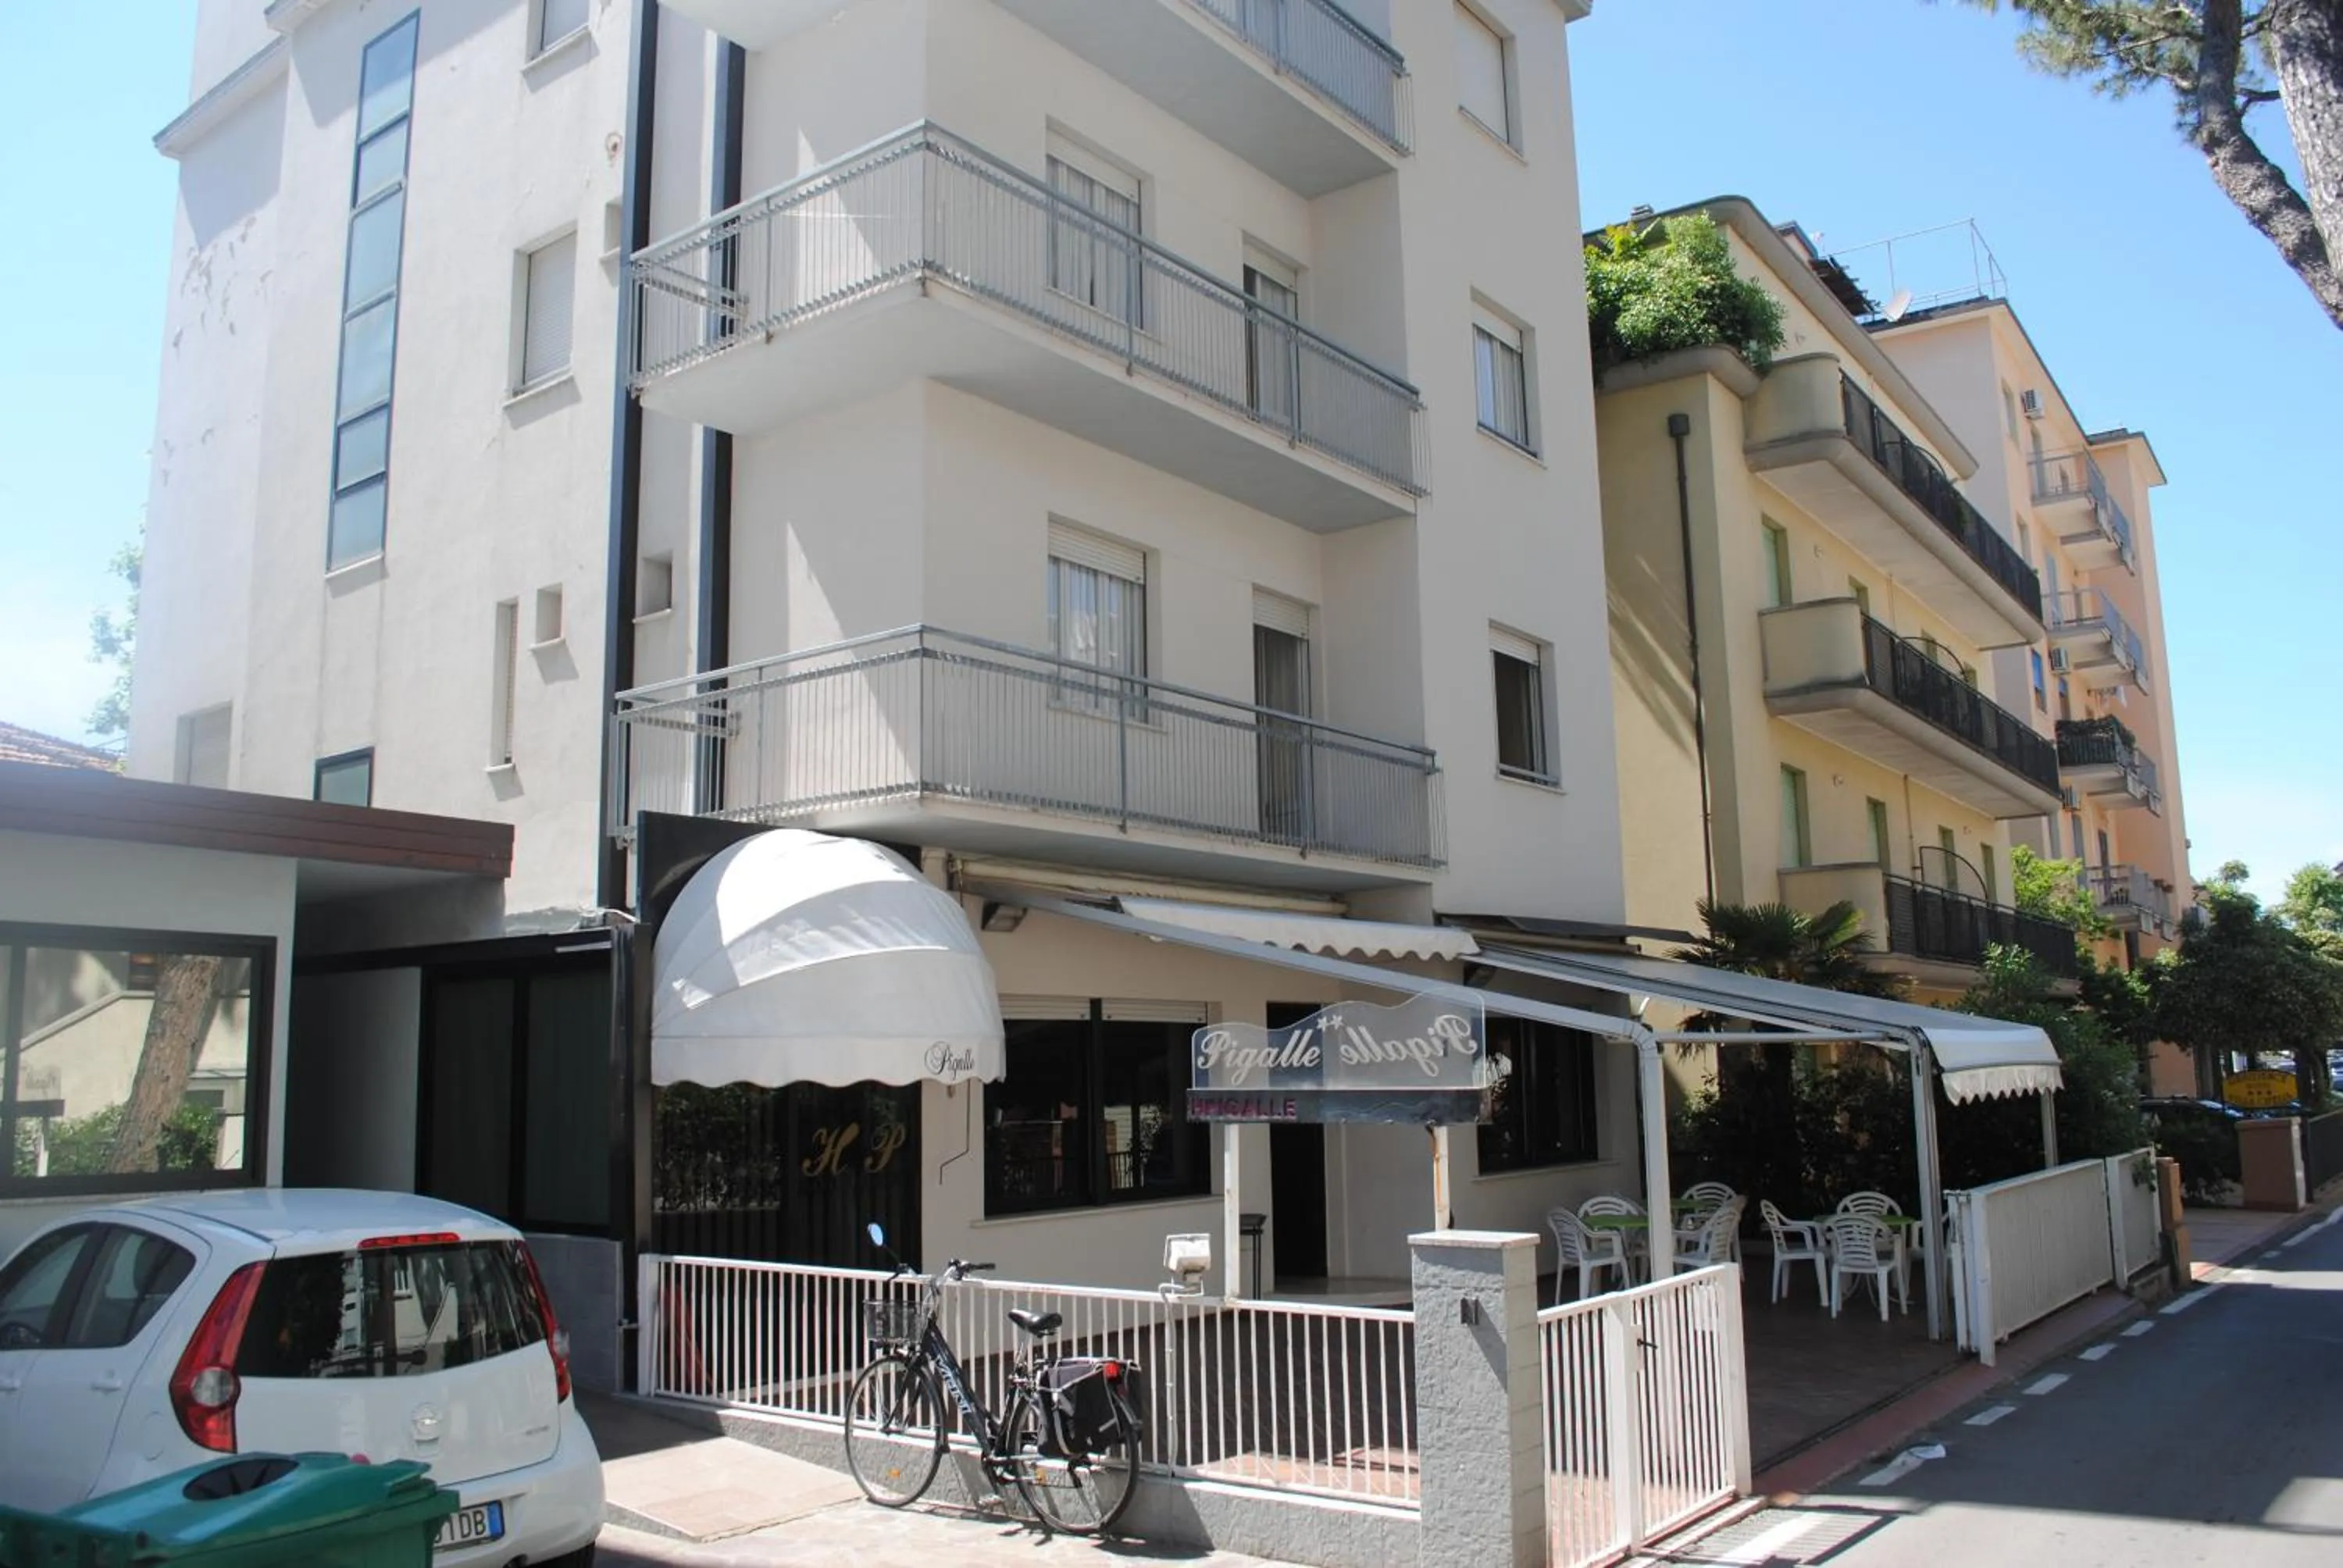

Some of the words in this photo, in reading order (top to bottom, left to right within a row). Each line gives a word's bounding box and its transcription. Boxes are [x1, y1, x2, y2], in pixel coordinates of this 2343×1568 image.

[924, 1040, 975, 1081] Pigalle
[1197, 1030, 1321, 1085] Pigalle
[802, 1122, 858, 1177] H
[865, 1123, 906, 1173] P
